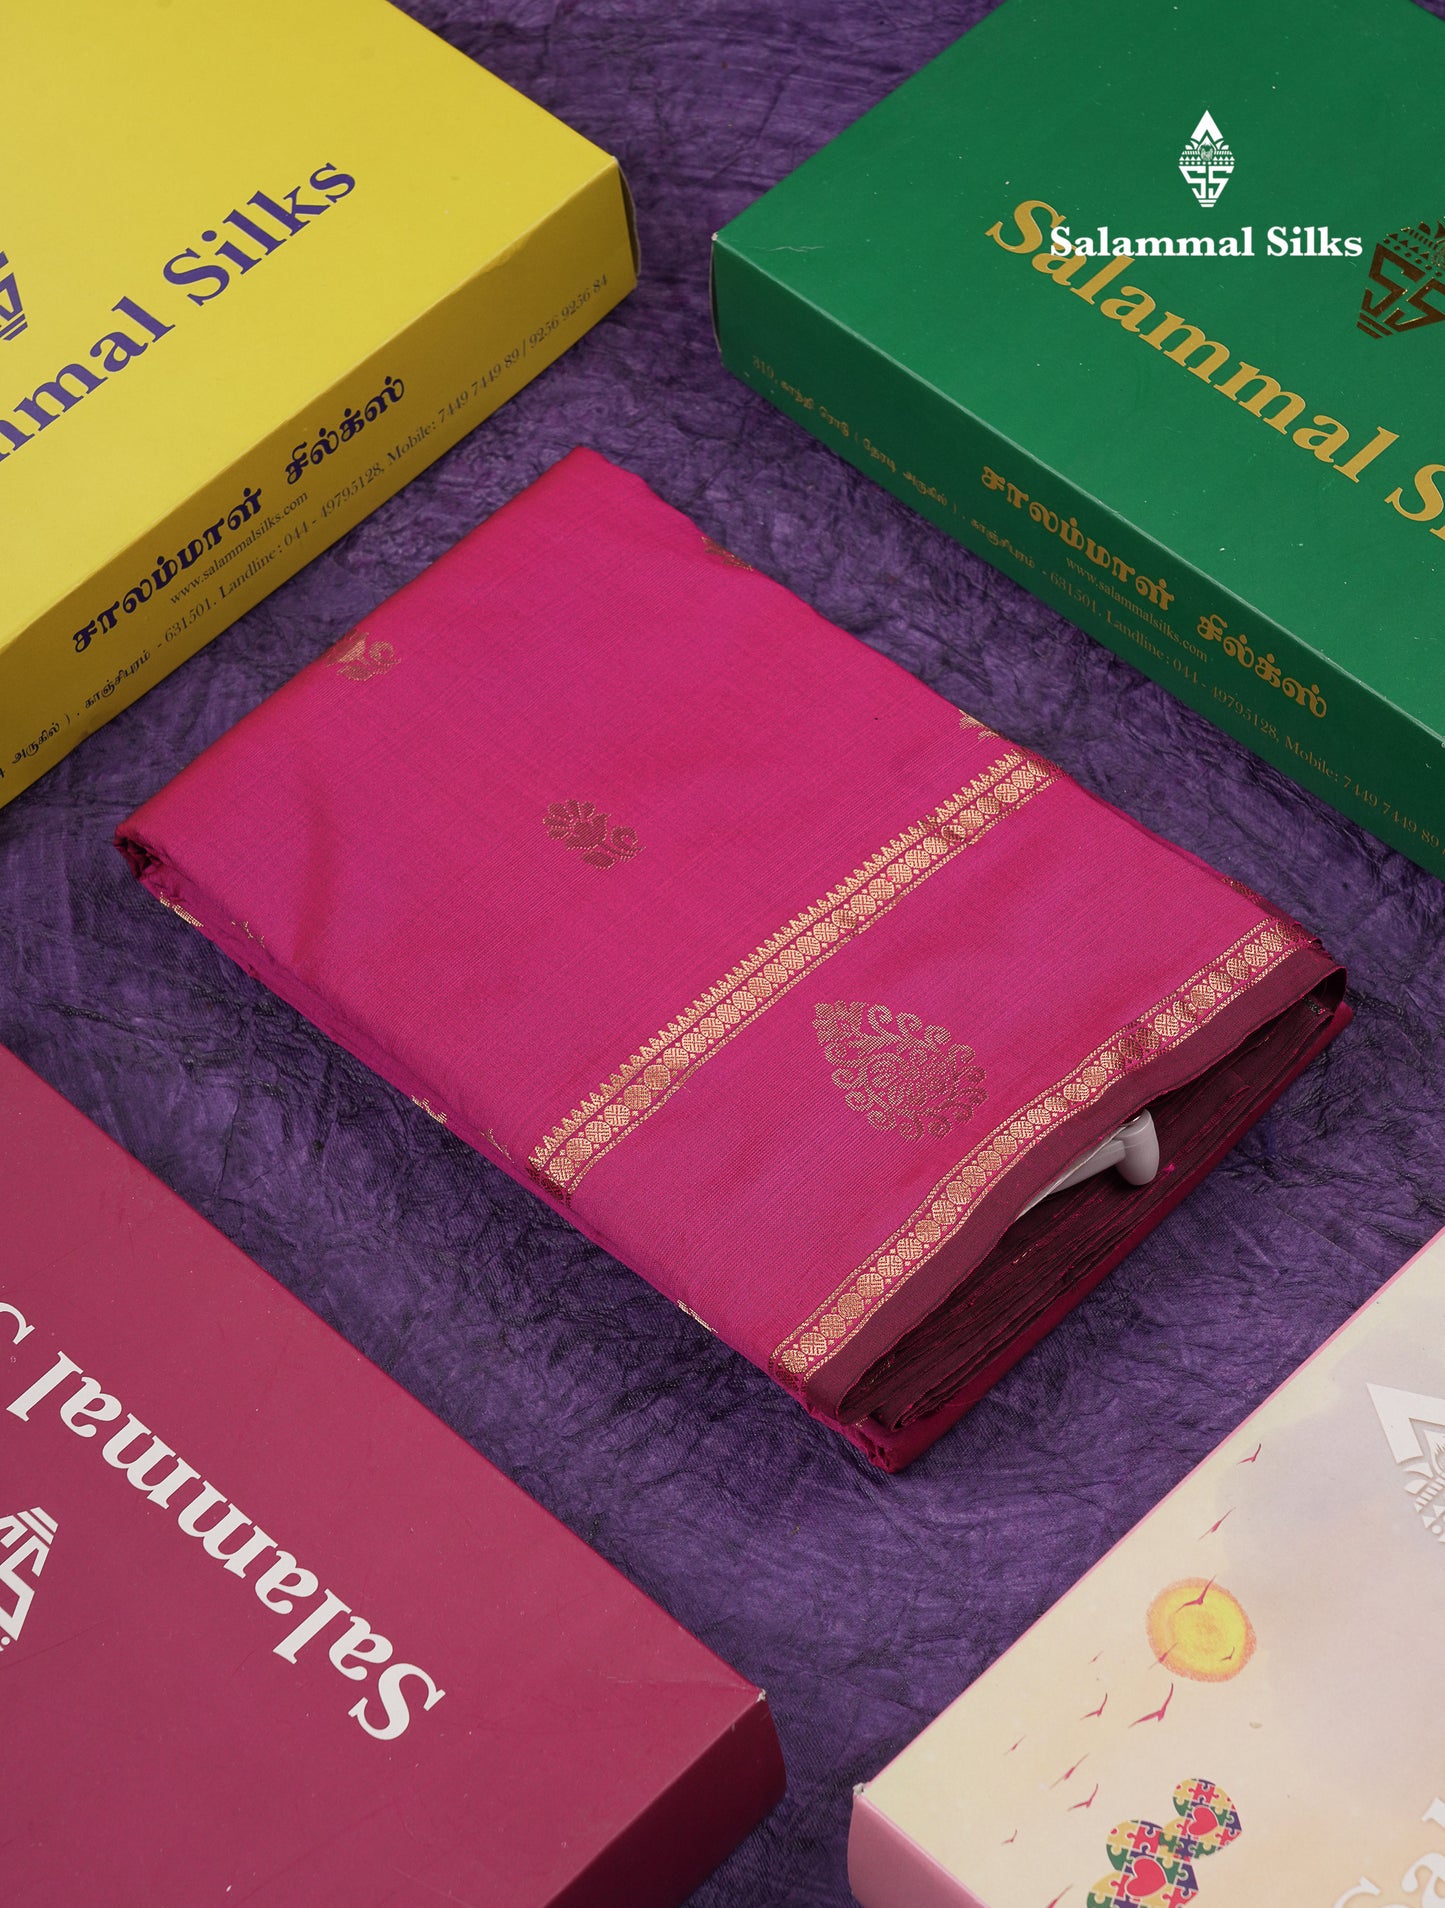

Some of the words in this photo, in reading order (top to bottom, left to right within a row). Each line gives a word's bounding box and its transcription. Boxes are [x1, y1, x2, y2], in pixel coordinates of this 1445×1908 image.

[163, 162, 356, 307] Silks
[985, 199, 1400, 483] Salammal
[1384, 463, 1445, 541] S
[72, 487, 262, 653] சாலம்மாள்
[284, 375, 405, 485] சில்க்ஸ்
[84, 649, 151, 710] காஞ்சிபுரம்
[387, 420, 437, 466] Mobile:
[437, 391, 470, 425] 7449
[471, 366, 502, 398] 7449
[170, 490, 308, 606] www.salammalsilks.com
[981, 465, 1175, 611] சாலம்மாள்
[1197, 614, 1327, 718] சில்க்ஸ்
[1066, 557, 1208, 663] www.salammalsilks.com
[1286, 735, 1339, 783] Mobile:
[1344, 776, 1379, 808] 7449
[1384, 803, 1418, 834] 7449
[6, 1350, 446, 1740] Salammal
